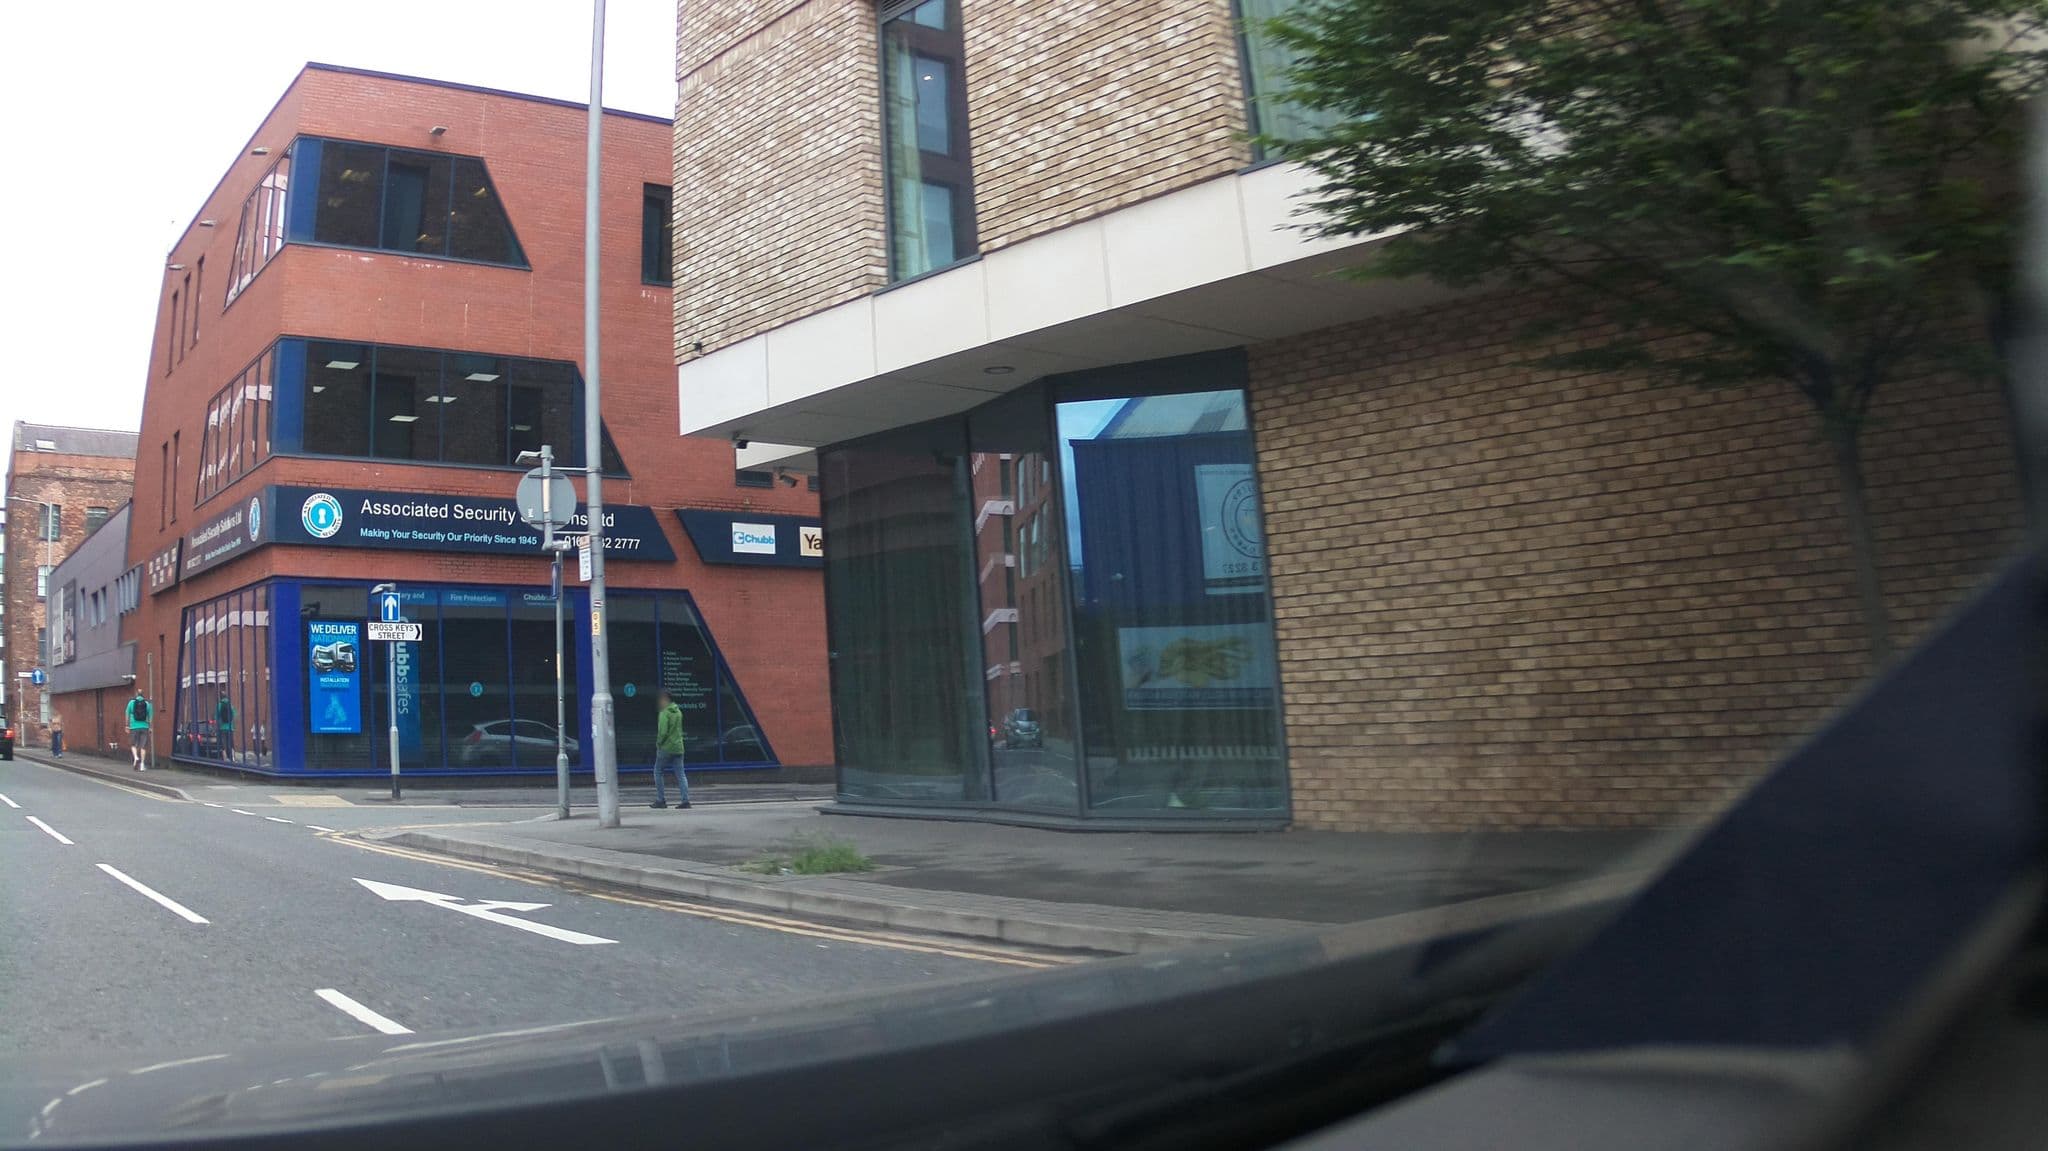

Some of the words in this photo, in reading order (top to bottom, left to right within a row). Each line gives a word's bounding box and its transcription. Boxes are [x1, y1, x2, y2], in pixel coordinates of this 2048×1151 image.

[360, 499, 449, 519] Associated
[453, 503, 516, 526] Security
[601, 513, 614, 527] td
[360, 528, 390, 540] Making
[391, 529, 411, 540] Your
[412, 530, 446, 543] Security
[447, 532, 463, 542] Our
[464, 533, 493, 545] Priority
[494, 534, 517, 544] Since
[519, 535, 538, 546] 1945
[744, 533, 775, 545] Chubb
[804, 534, 823, 550] Ya
[615, 538, 641, 550] 2777
[450, 593, 463, 601] Fire
[463, 594, 497, 602] Protection
[311, 624, 324, 634] WE
[325, 625, 357, 635] DELIVER
[369, 624, 393, 632] CROSS
[395, 624, 414, 632] KEYS
[378, 632, 405, 640] STREET
